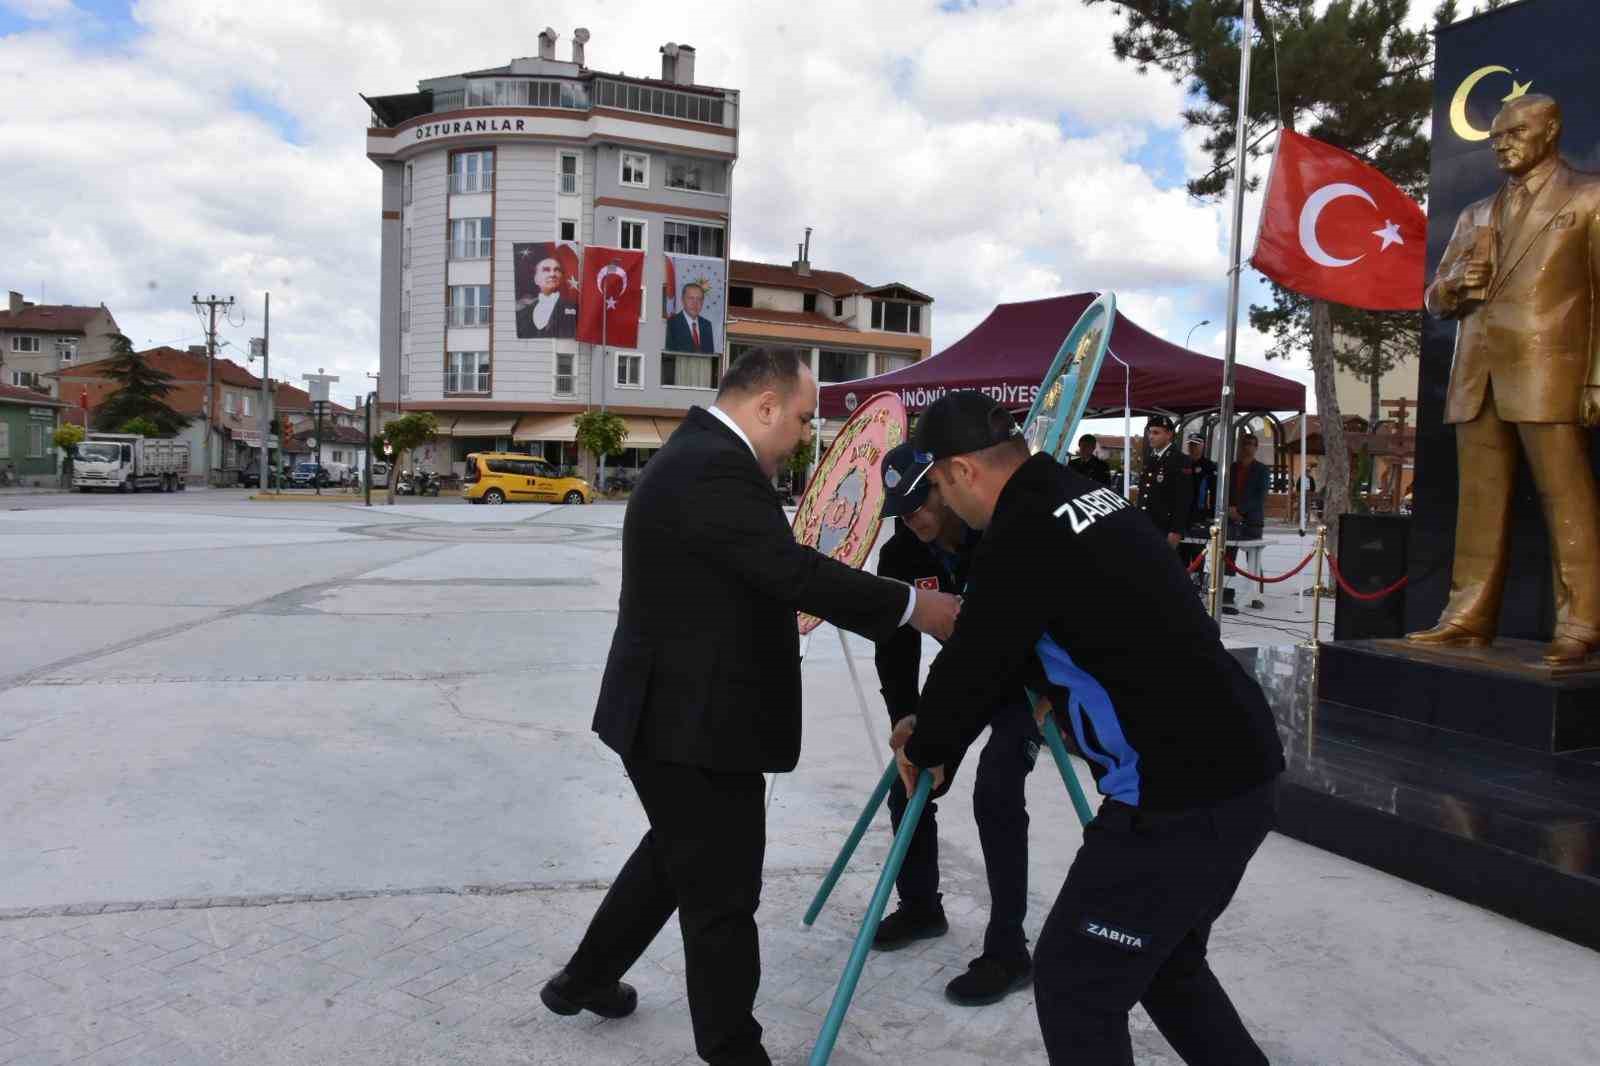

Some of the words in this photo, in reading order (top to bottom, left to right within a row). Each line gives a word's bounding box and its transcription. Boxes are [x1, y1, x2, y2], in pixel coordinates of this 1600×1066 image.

[415, 119, 525, 139] ÖZTURANLAR
[951, 382, 1040, 402] EDİYES
[1053, 486, 1131, 534] ZABITA
[1087, 922, 1143, 948] ZABITA
